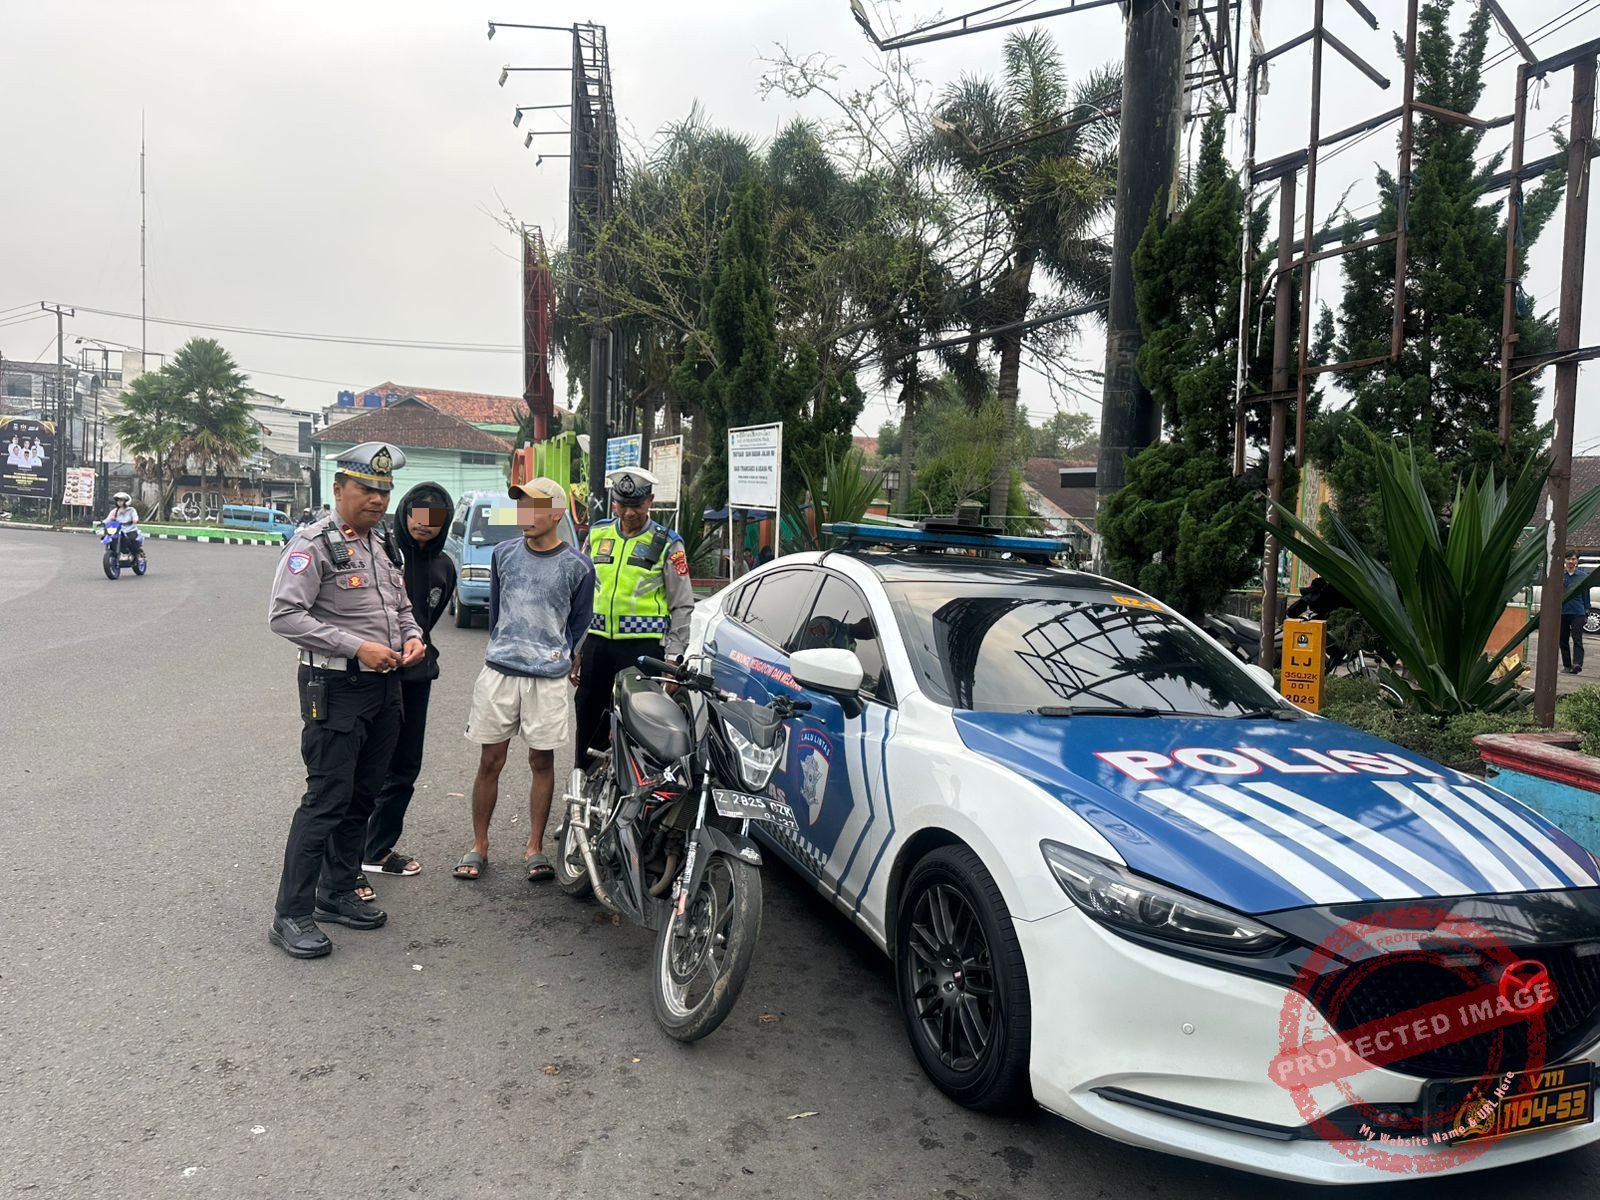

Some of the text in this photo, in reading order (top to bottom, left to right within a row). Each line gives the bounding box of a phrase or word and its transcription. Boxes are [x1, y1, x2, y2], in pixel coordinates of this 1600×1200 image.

[1285, 694, 1315, 704] 2025
[1092, 747, 1446, 782] POLISI
[716, 792, 728, 803] Z
[732, 793, 766, 808] 2825
[1503, 1090, 1586, 1129] 1104-53
